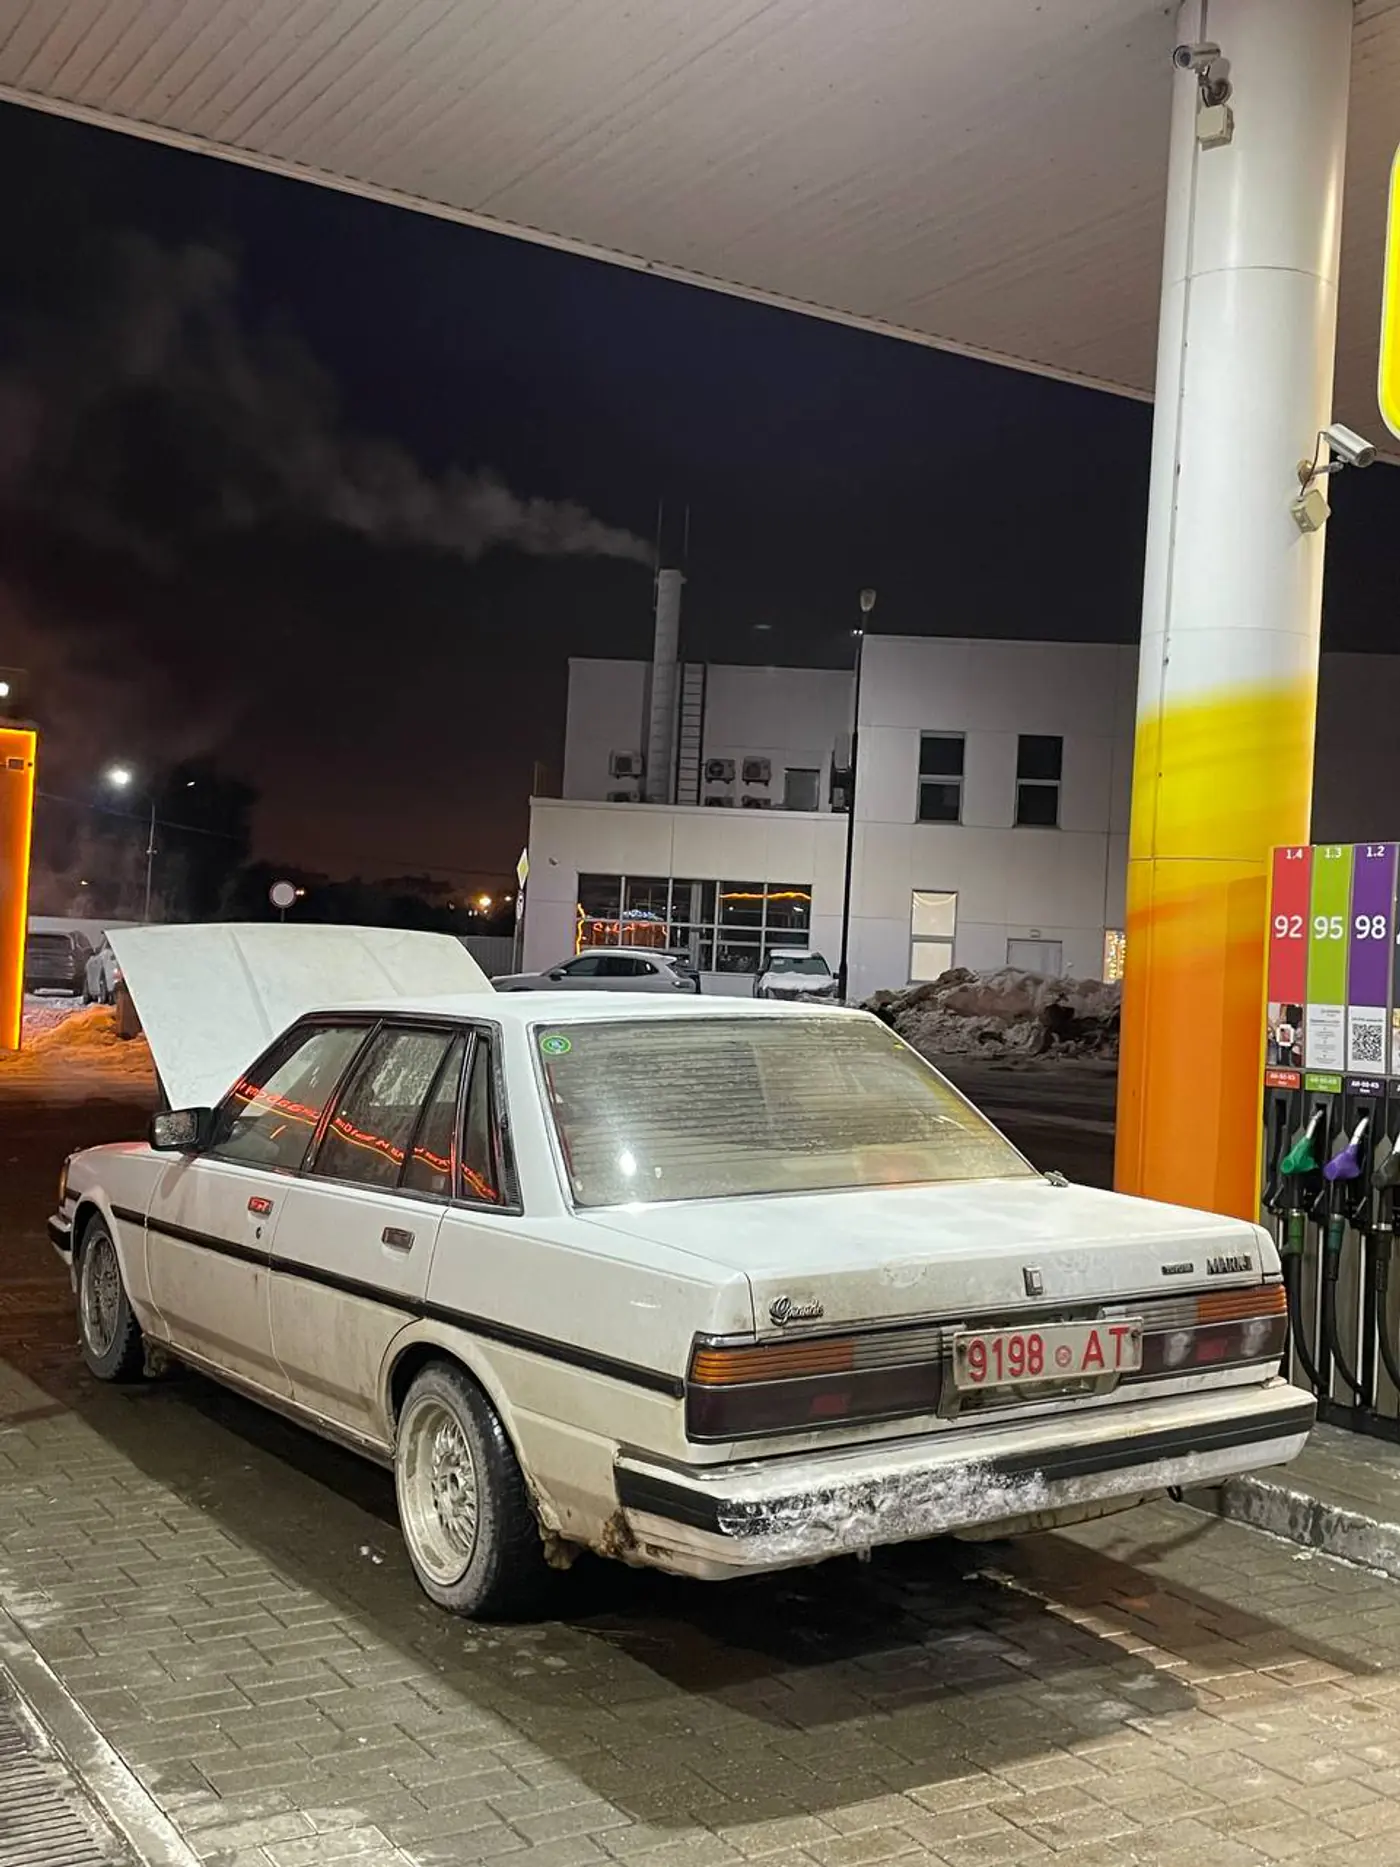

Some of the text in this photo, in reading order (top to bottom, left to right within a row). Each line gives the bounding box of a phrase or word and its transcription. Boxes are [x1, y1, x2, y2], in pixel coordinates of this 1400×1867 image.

[1286, 848, 1303, 859] 1.4
[1366, 846, 1385, 857] 1.2
[1275, 915, 1303, 938] 92
[1314, 916, 1343, 939] 95
[1355, 915, 1386, 939] 98
[968, 1333, 1044, 1383] 9198
[1081, 1326, 1130, 1371] AT
